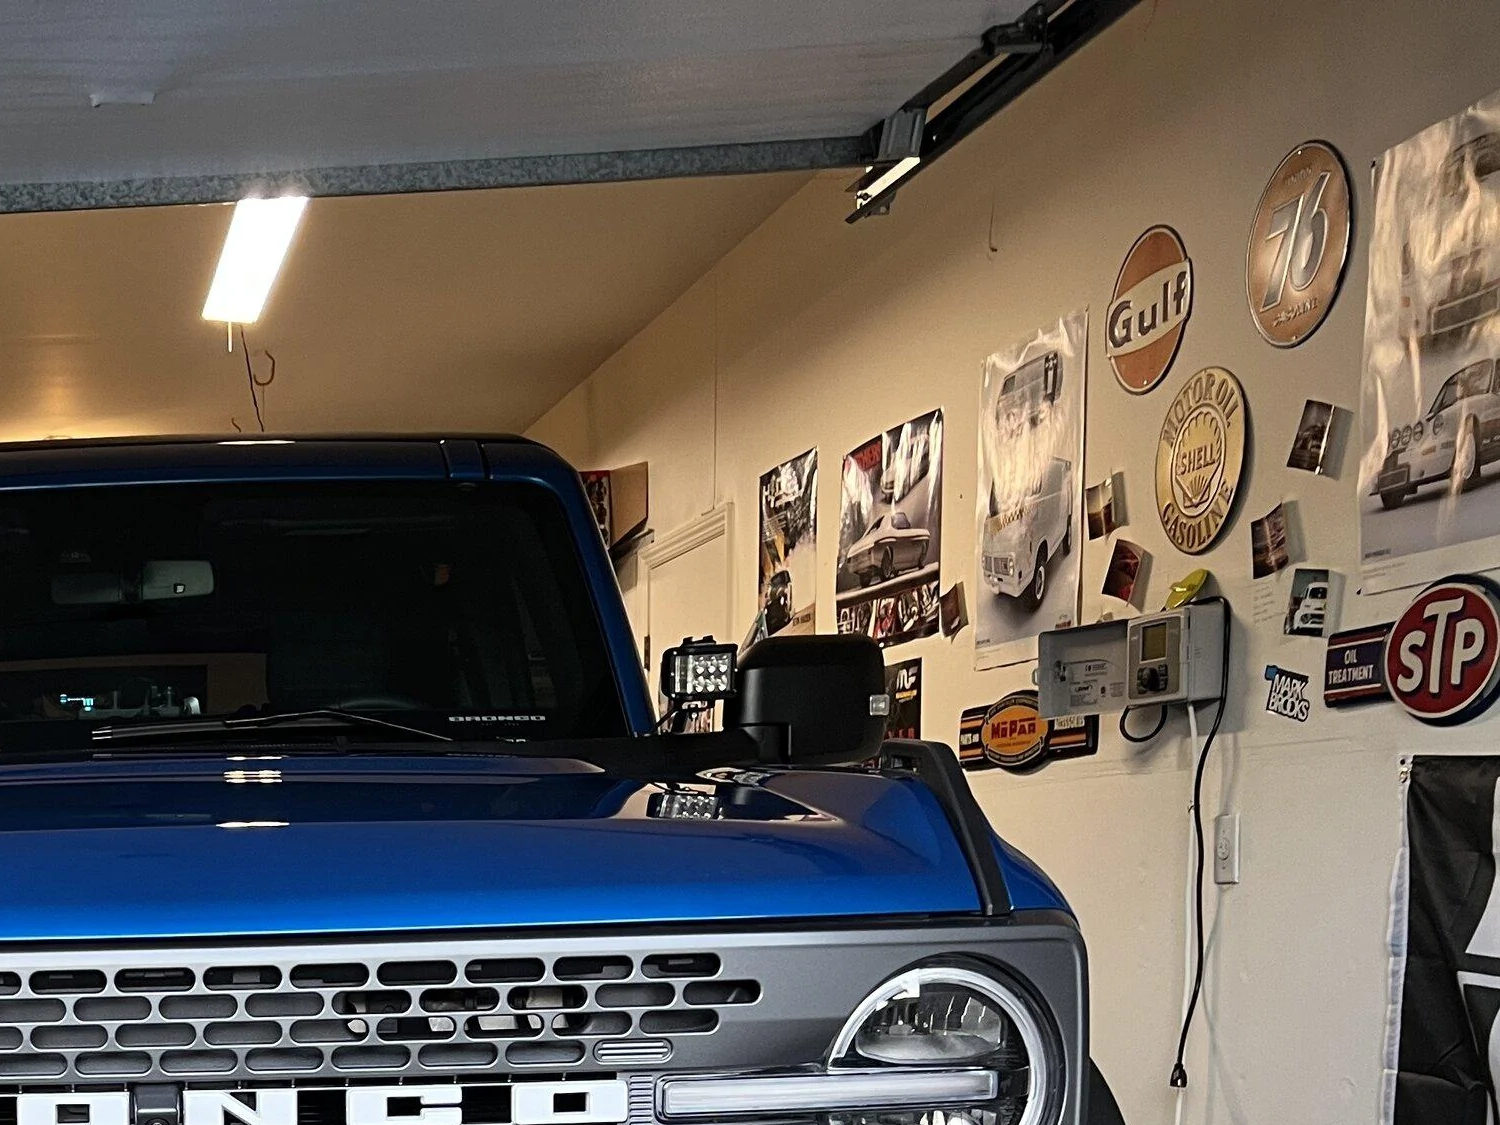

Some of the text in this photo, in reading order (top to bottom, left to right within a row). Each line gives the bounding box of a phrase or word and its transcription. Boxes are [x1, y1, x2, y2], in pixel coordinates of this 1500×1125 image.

[1259, 171, 1331, 313] 76
[1108, 271, 1188, 349] Gulf
[1163, 373, 1217, 448] MOTOR
[1180, 443, 1216, 475] SHELL
[1162, 478, 1234, 549] GASOLINE
[1344, 649, 1358, 665] OIL
[1396, 595, 1485, 694] STP
[1272, 673, 1306, 701] MARK
[1328, 664, 1374, 685] TREATMENT
[1268, 690, 1309, 720] BROOKS
